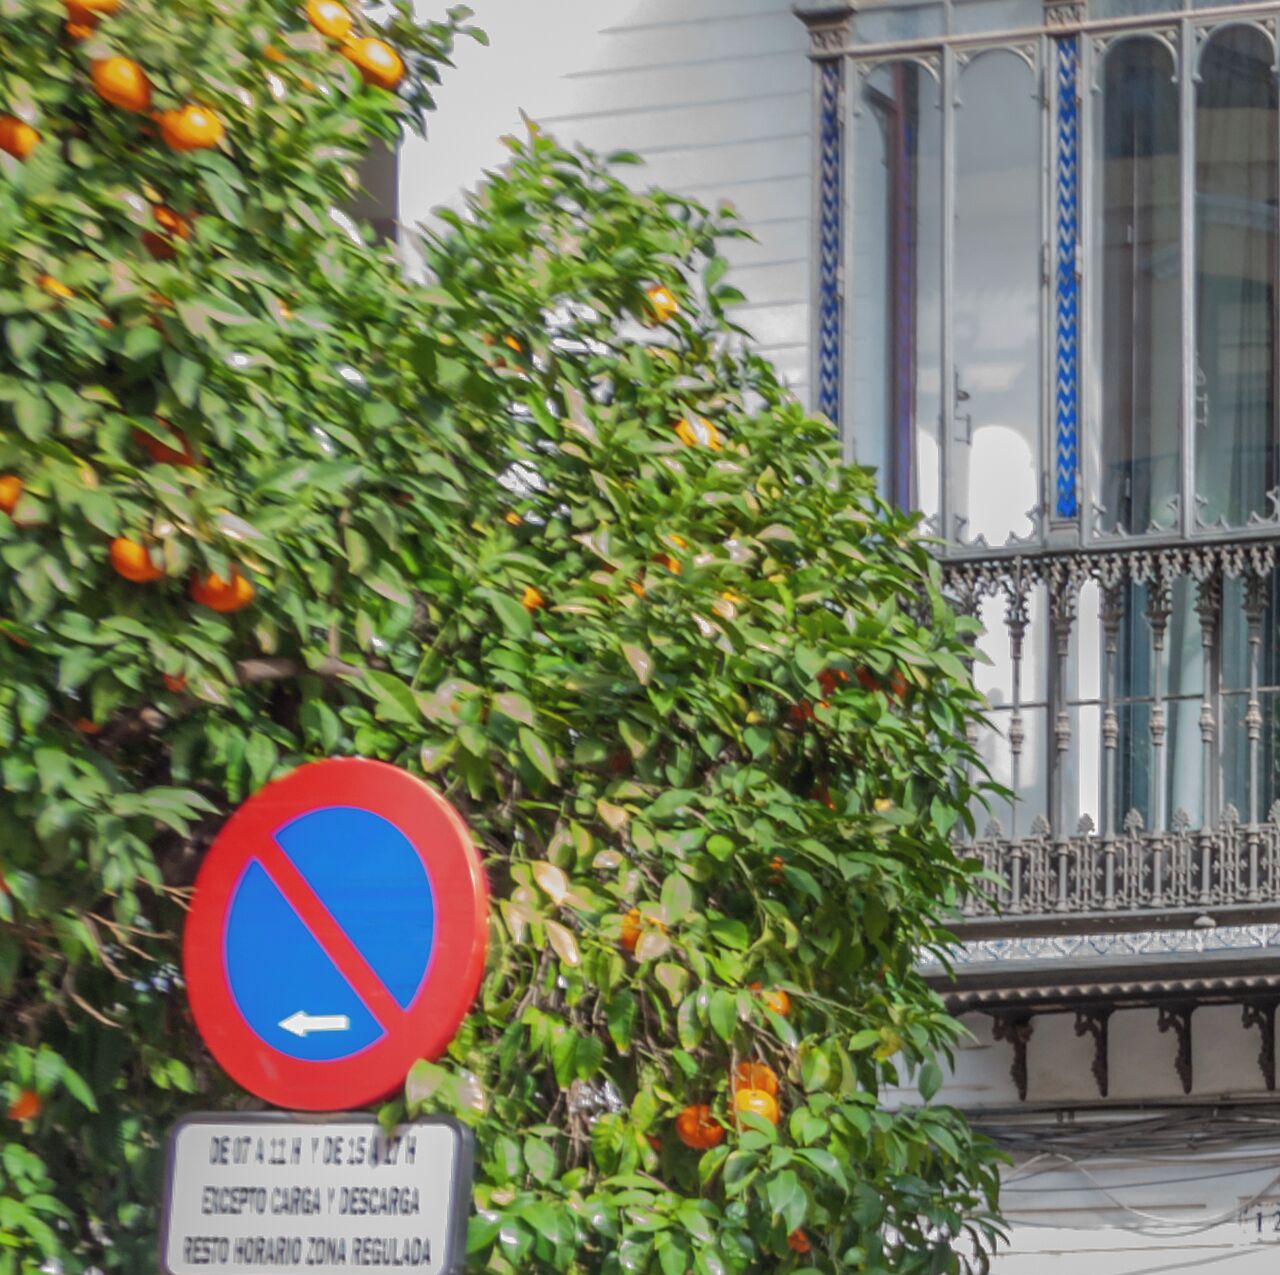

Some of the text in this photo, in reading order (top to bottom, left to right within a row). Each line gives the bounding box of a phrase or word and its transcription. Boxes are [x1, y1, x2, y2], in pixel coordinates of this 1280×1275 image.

[209, 1136, 229, 1165] DE
[233, 1136, 251, 1164] 07
[255, 1136, 265, 1164] A
[268, 1137, 286, 1164] 11
[290, 1137, 302, 1164] H
[311, 1137, 320, 1164] Y
[323, 1136, 343, 1165] DE
[347, 1136, 366, 1165] 15
[405, 1136, 417, 1164] H
[201, 1185, 420, 1216] EXCEPTO CARGA Y DESCARGA
[183, 1236, 432, 1266] RESTO HORARIO ZONA REGULADA
